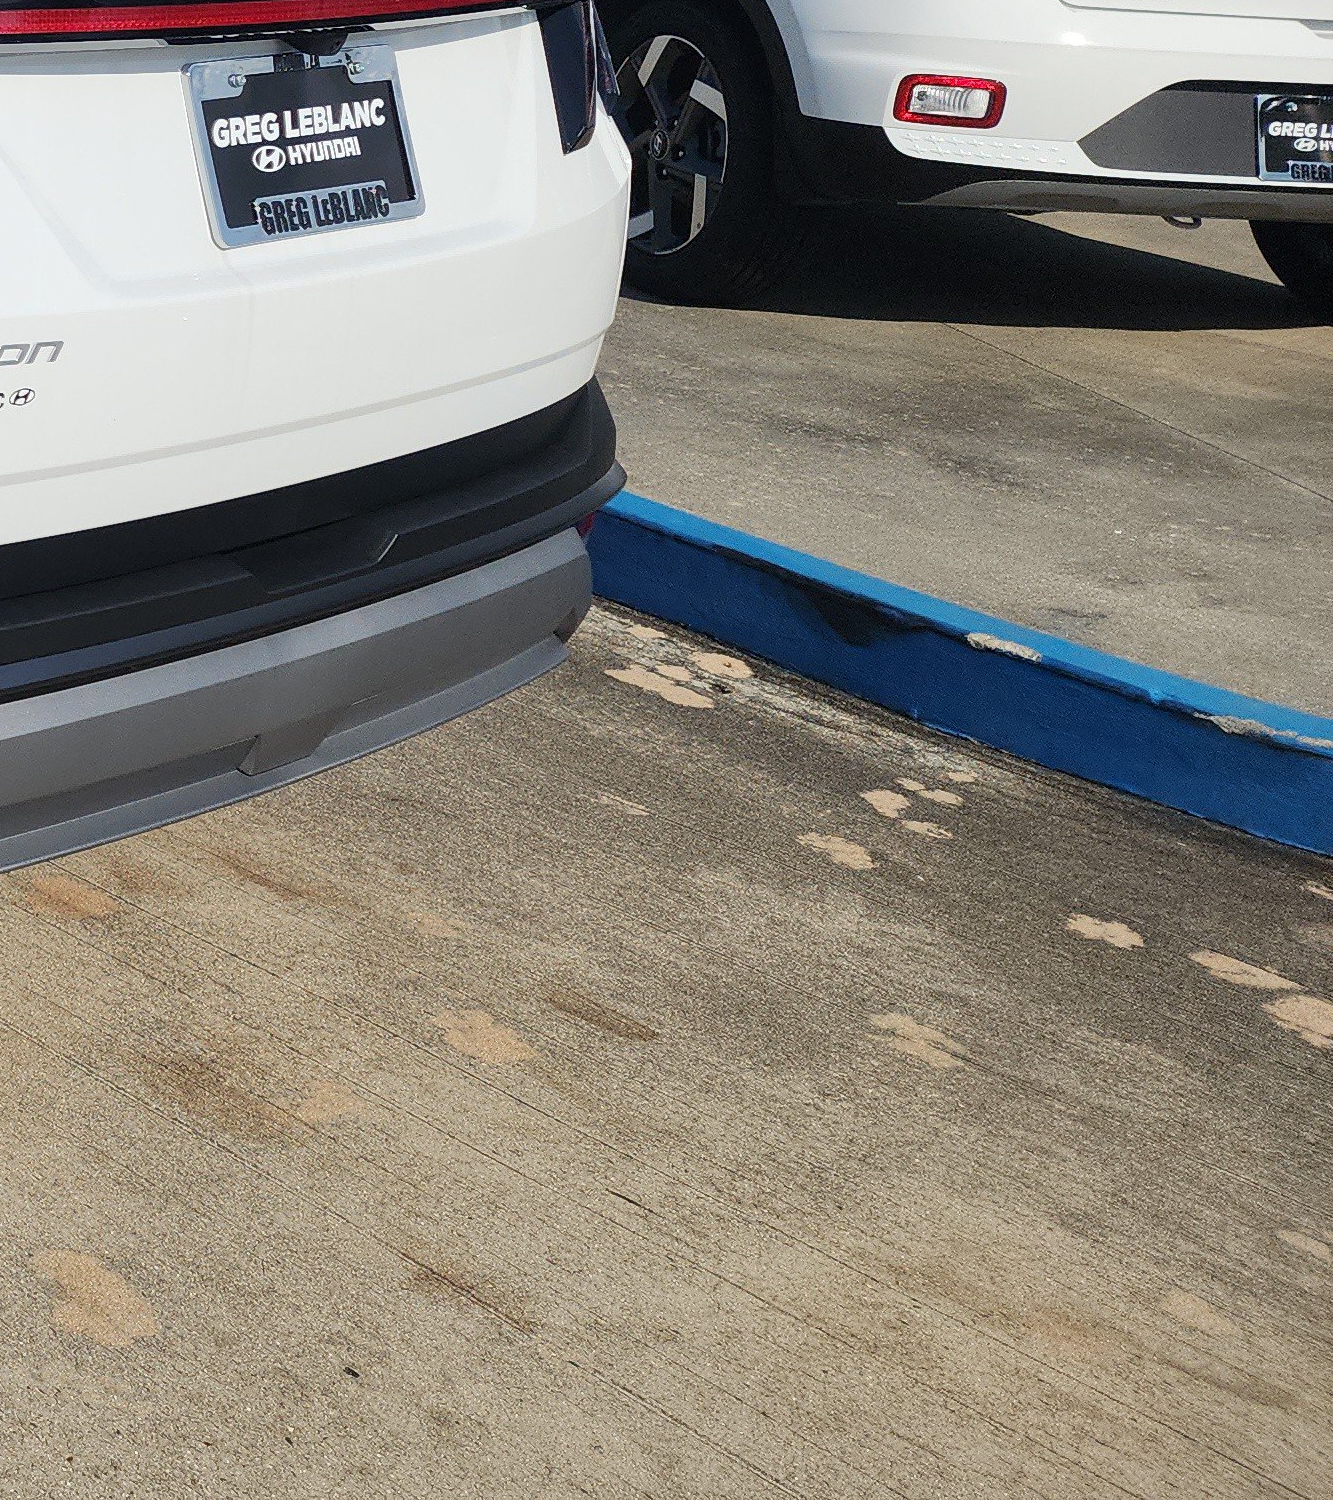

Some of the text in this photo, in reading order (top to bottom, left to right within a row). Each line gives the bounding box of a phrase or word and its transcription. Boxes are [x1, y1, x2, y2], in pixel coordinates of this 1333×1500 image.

[212, 98, 386, 148] GREG LEBLANC
[1268, 121, 1317, 137] GREG
[289, 136, 361, 165] HYUNDAI
[1291, 164, 1331, 179] GREG
[259, 185, 390, 235] GREG LEBLANC
